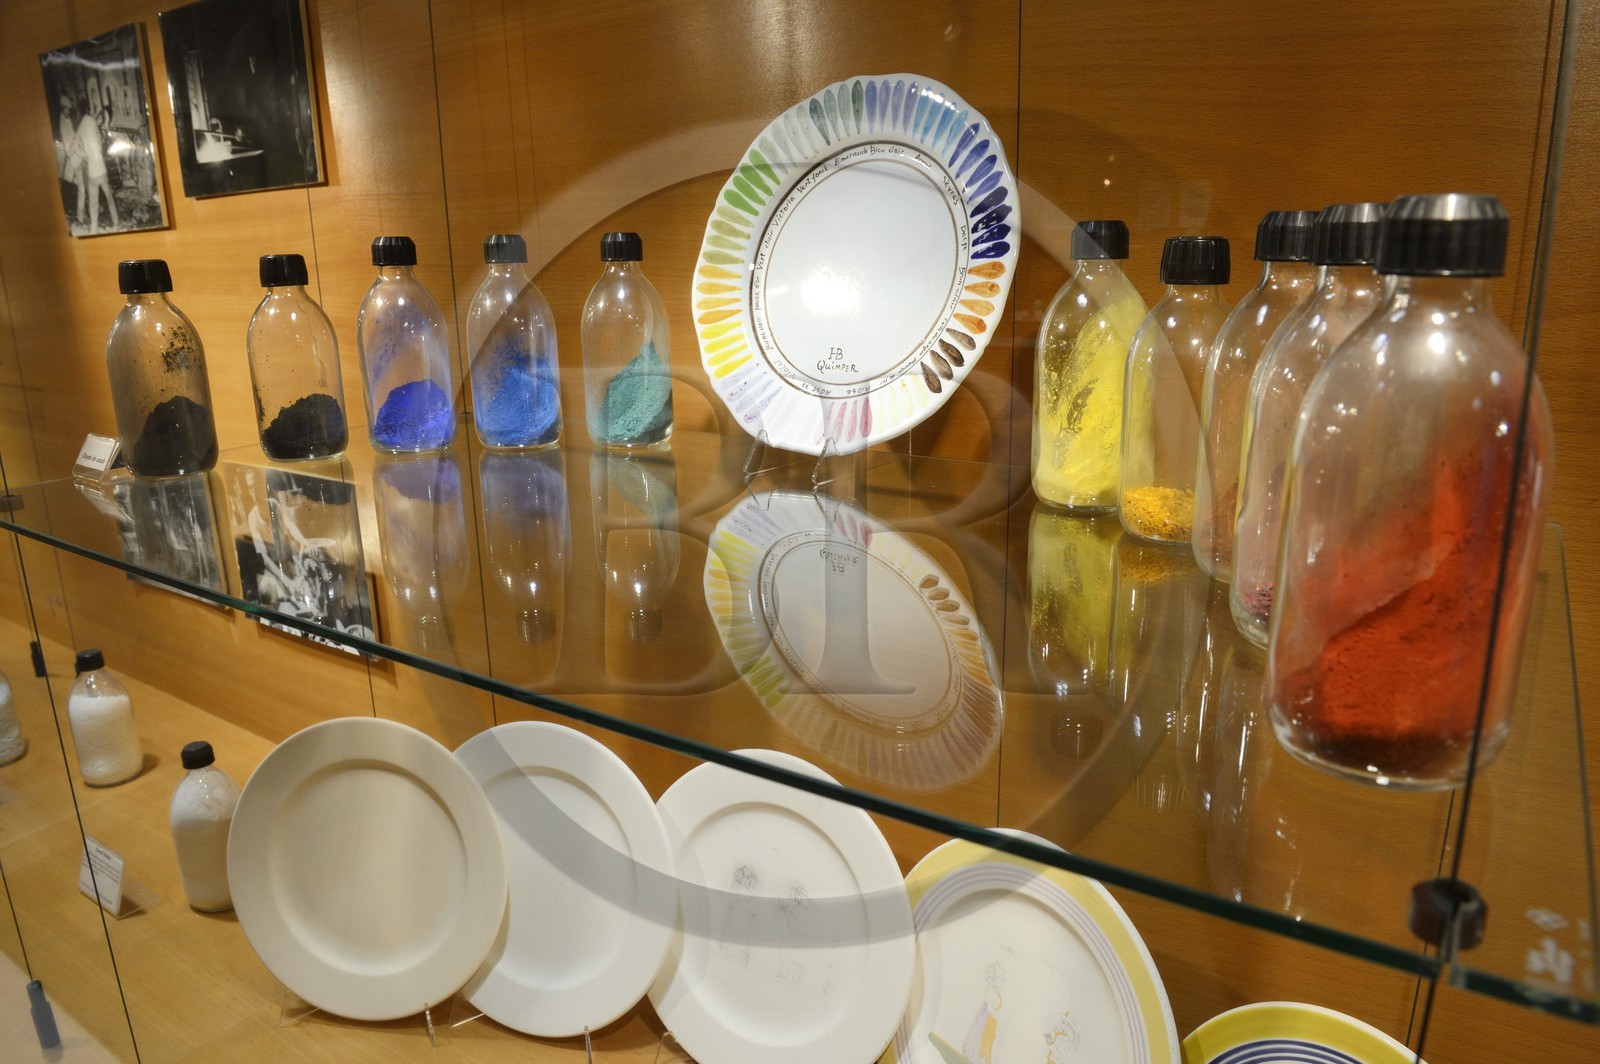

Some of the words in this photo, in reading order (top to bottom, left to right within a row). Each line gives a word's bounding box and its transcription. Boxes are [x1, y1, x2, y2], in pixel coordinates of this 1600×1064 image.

[797, 179, 811, 194] Vert
[772, 196, 795, 227] Victoria
[756, 253, 765, 270] Vert
